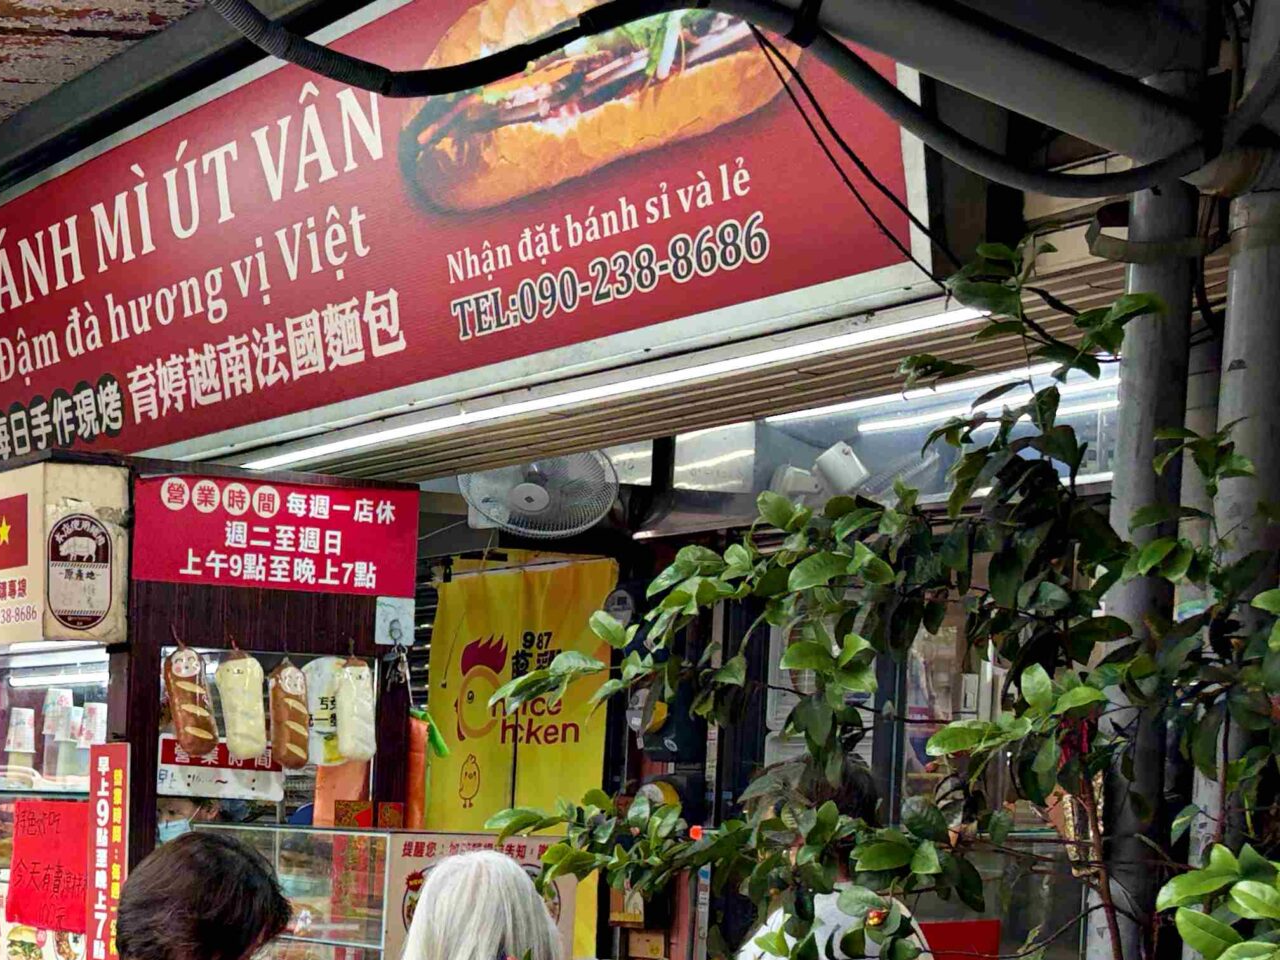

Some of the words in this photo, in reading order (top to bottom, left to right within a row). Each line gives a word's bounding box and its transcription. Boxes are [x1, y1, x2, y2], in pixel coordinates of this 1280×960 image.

[91, 163, 156, 273] MÌ
[163, 139, 238, 239] ÚT
[251, 81, 384, 202] VÂN
[446, 239, 512, 284] Nhận
[518, 222, 564, 267] đặt
[567, 197, 639, 249] bánh
[645, 182, 671, 222] sỉ
[676, 171, 715, 213] và
[719, 156, 752, 202] lẻ
[66, 302, 101, 358] đà
[111, 266, 227, 343] hương
[231, 237, 271, 305] vị
[276, 205, 371, 282] Việt
[452, 211, 769, 341] TEL:090-238-8686
[126, 287, 407, 425] 育婷越南法國麵包
[167, 479, 277, 514] 營業時間
[286, 492, 396, 525] 每週一店休
[224, 521, 343, 556] 週二至週日
[179, 548, 377, 589] 上午9點至晚上7點
